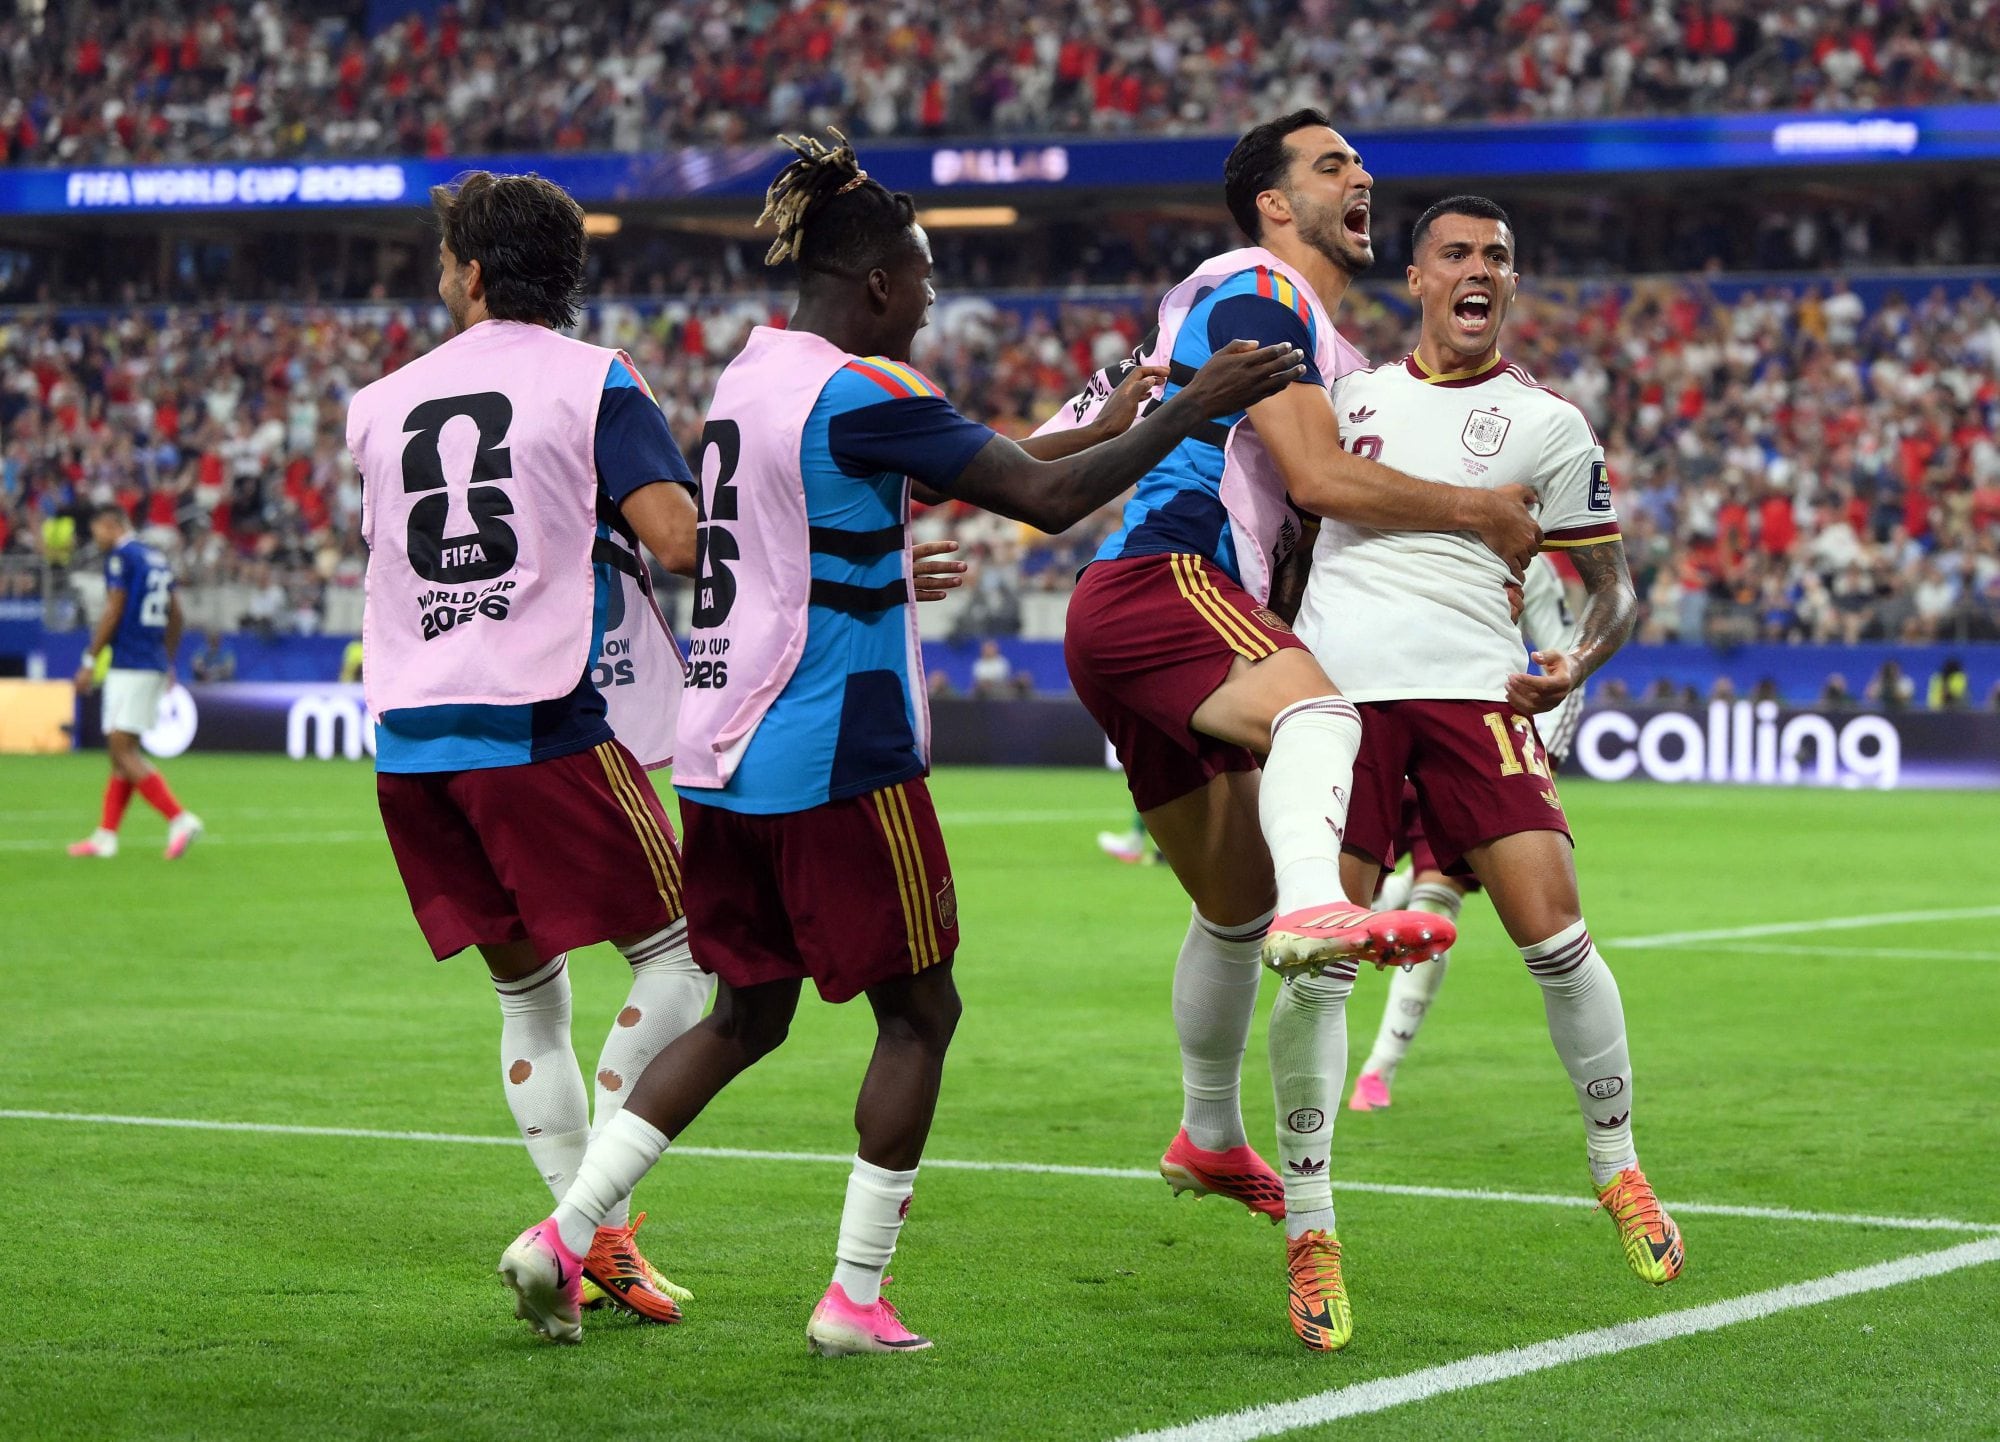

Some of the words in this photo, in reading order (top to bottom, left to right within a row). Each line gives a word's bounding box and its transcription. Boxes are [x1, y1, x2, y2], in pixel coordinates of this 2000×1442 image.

[68, 173, 130, 205] FIFA
[132, 170, 237, 204] WORLD
[238, 168, 298, 202] CUP
[300, 165, 404, 200] 2026
[441, 543, 487, 569] FIFA
[417, 589, 477, 611] WORLD
[709, 638, 730, 655] CUP
[684, 661, 728, 689] 226
[1483, 711, 1548, 780] 12
[1577, 700, 1900, 788] calling
